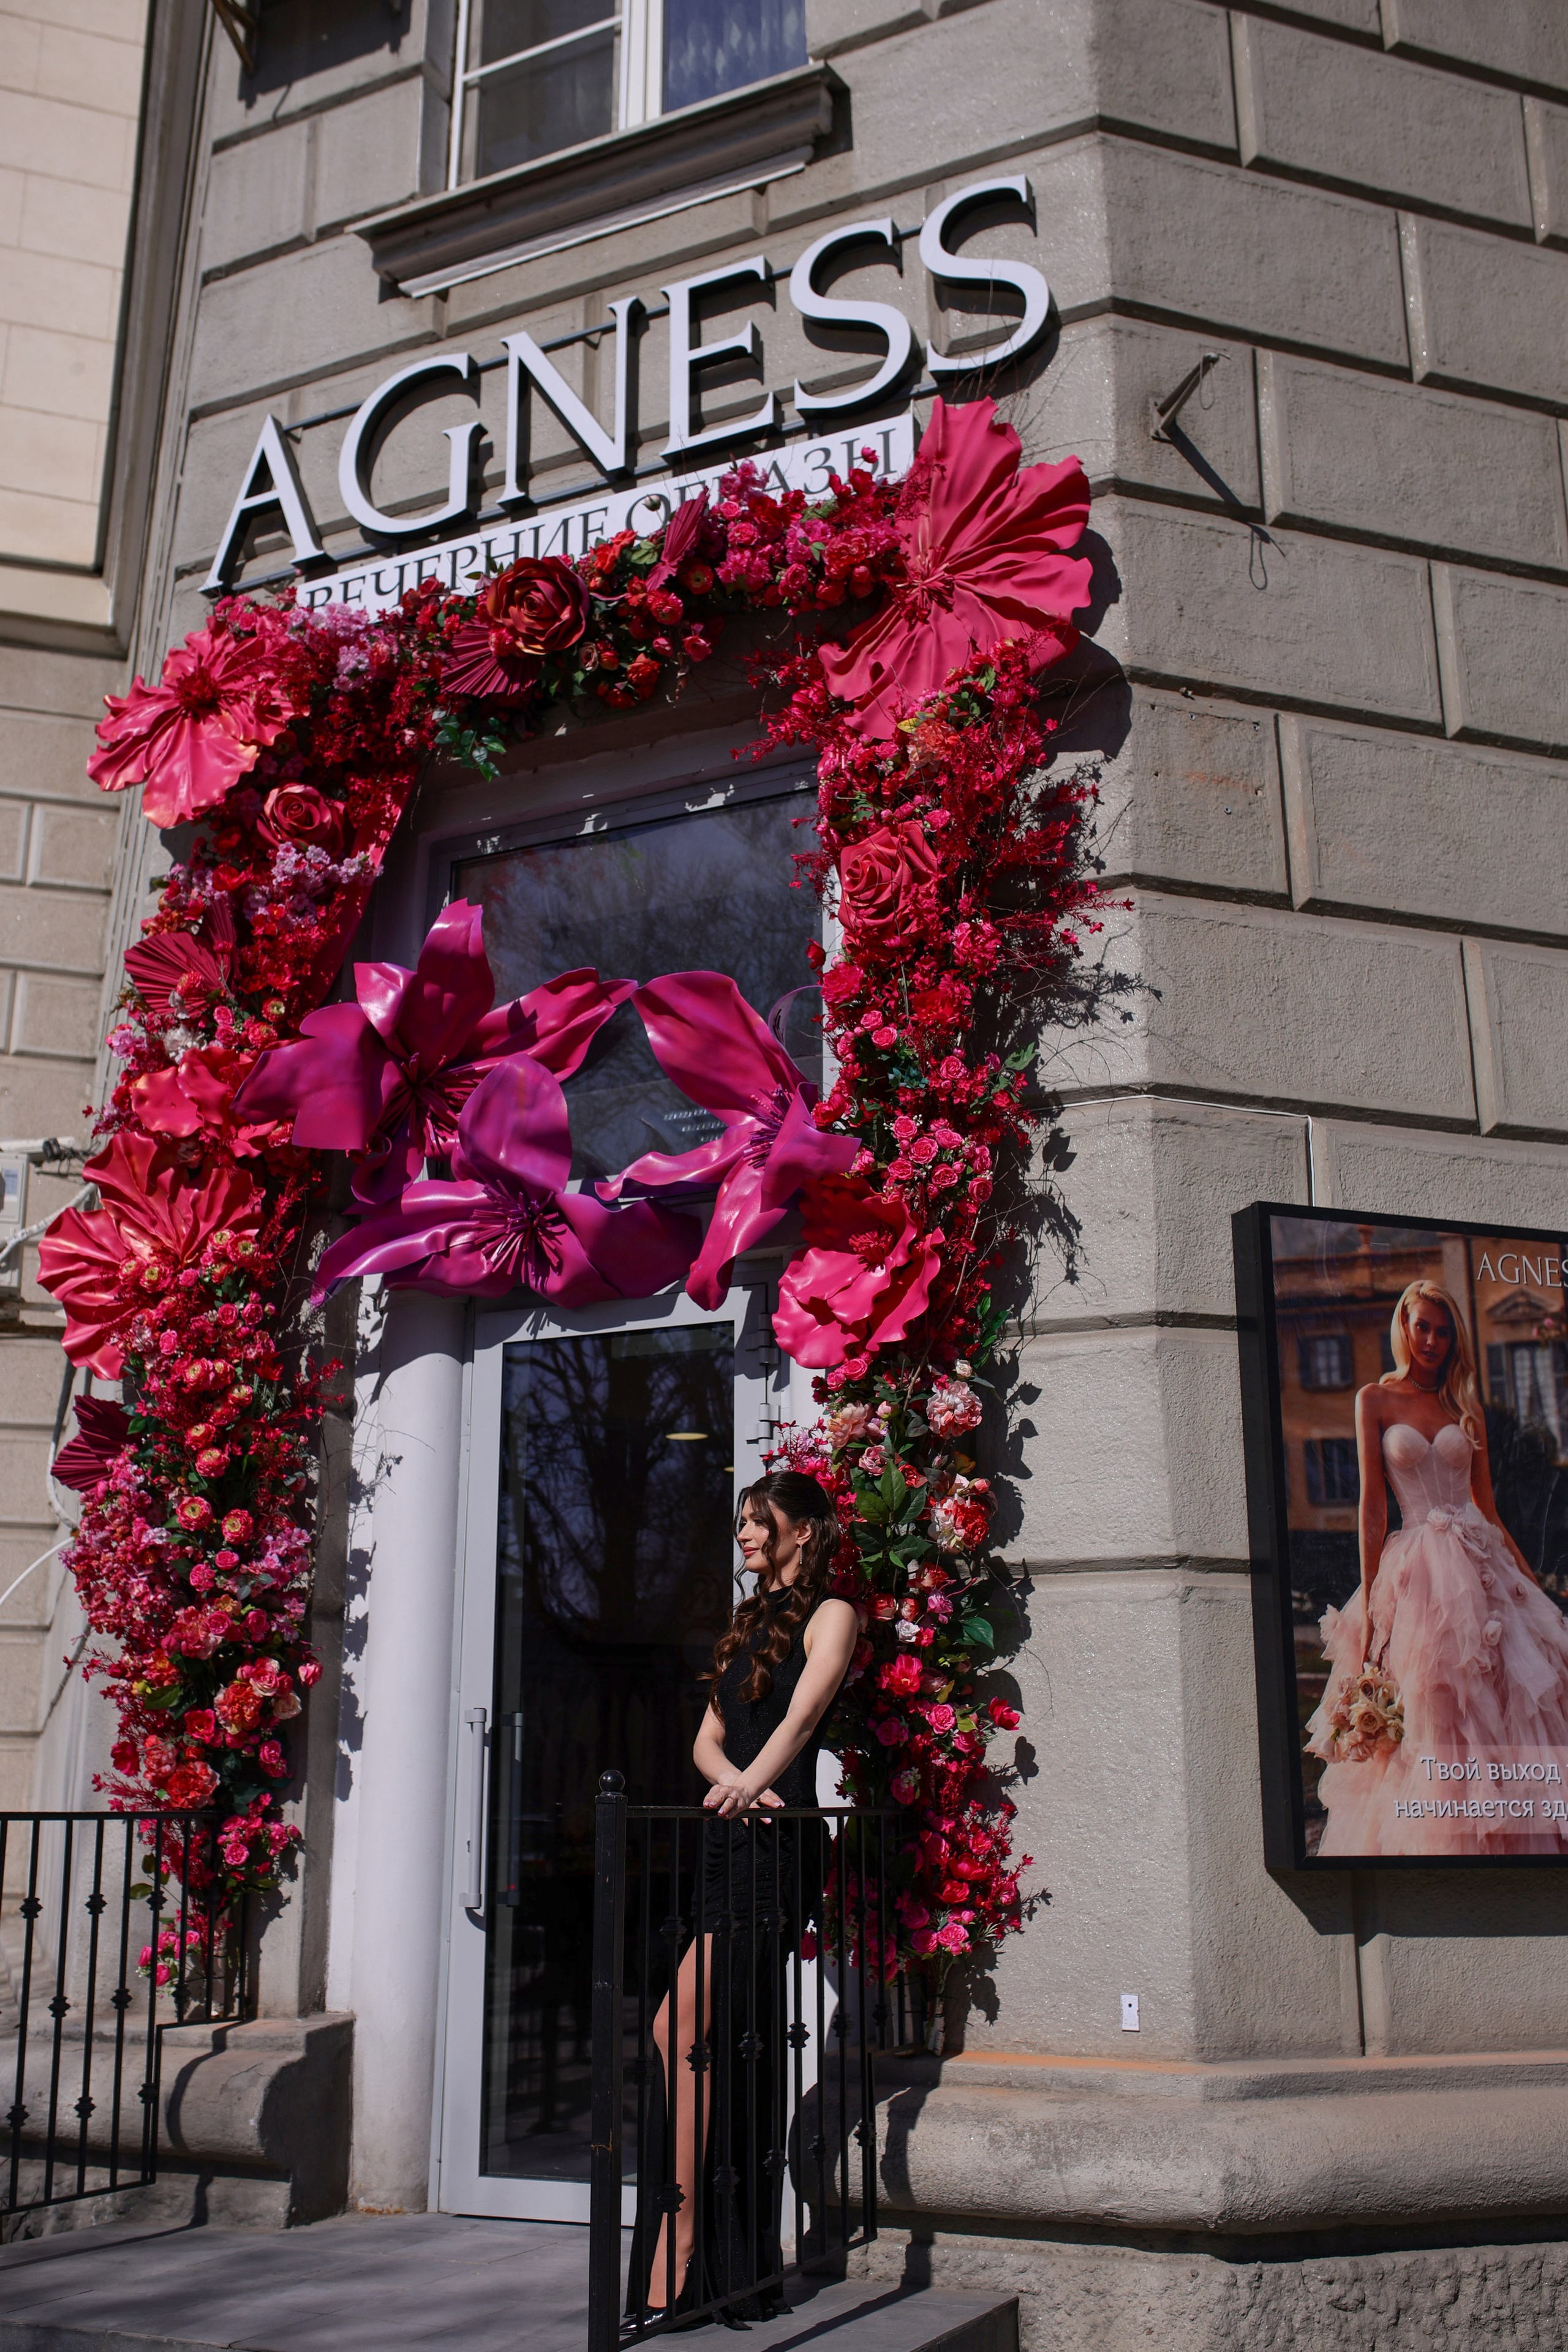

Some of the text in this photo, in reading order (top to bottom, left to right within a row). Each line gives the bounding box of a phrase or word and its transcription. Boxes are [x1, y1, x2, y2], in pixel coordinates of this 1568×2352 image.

[197, 174, 1052, 596] AGNESS
[625, 428, 895, 540] ОАЗЫ
[1420, 1756, 1562, 1784] Твой выход
[1393, 1799, 1534, 1819] начинается
